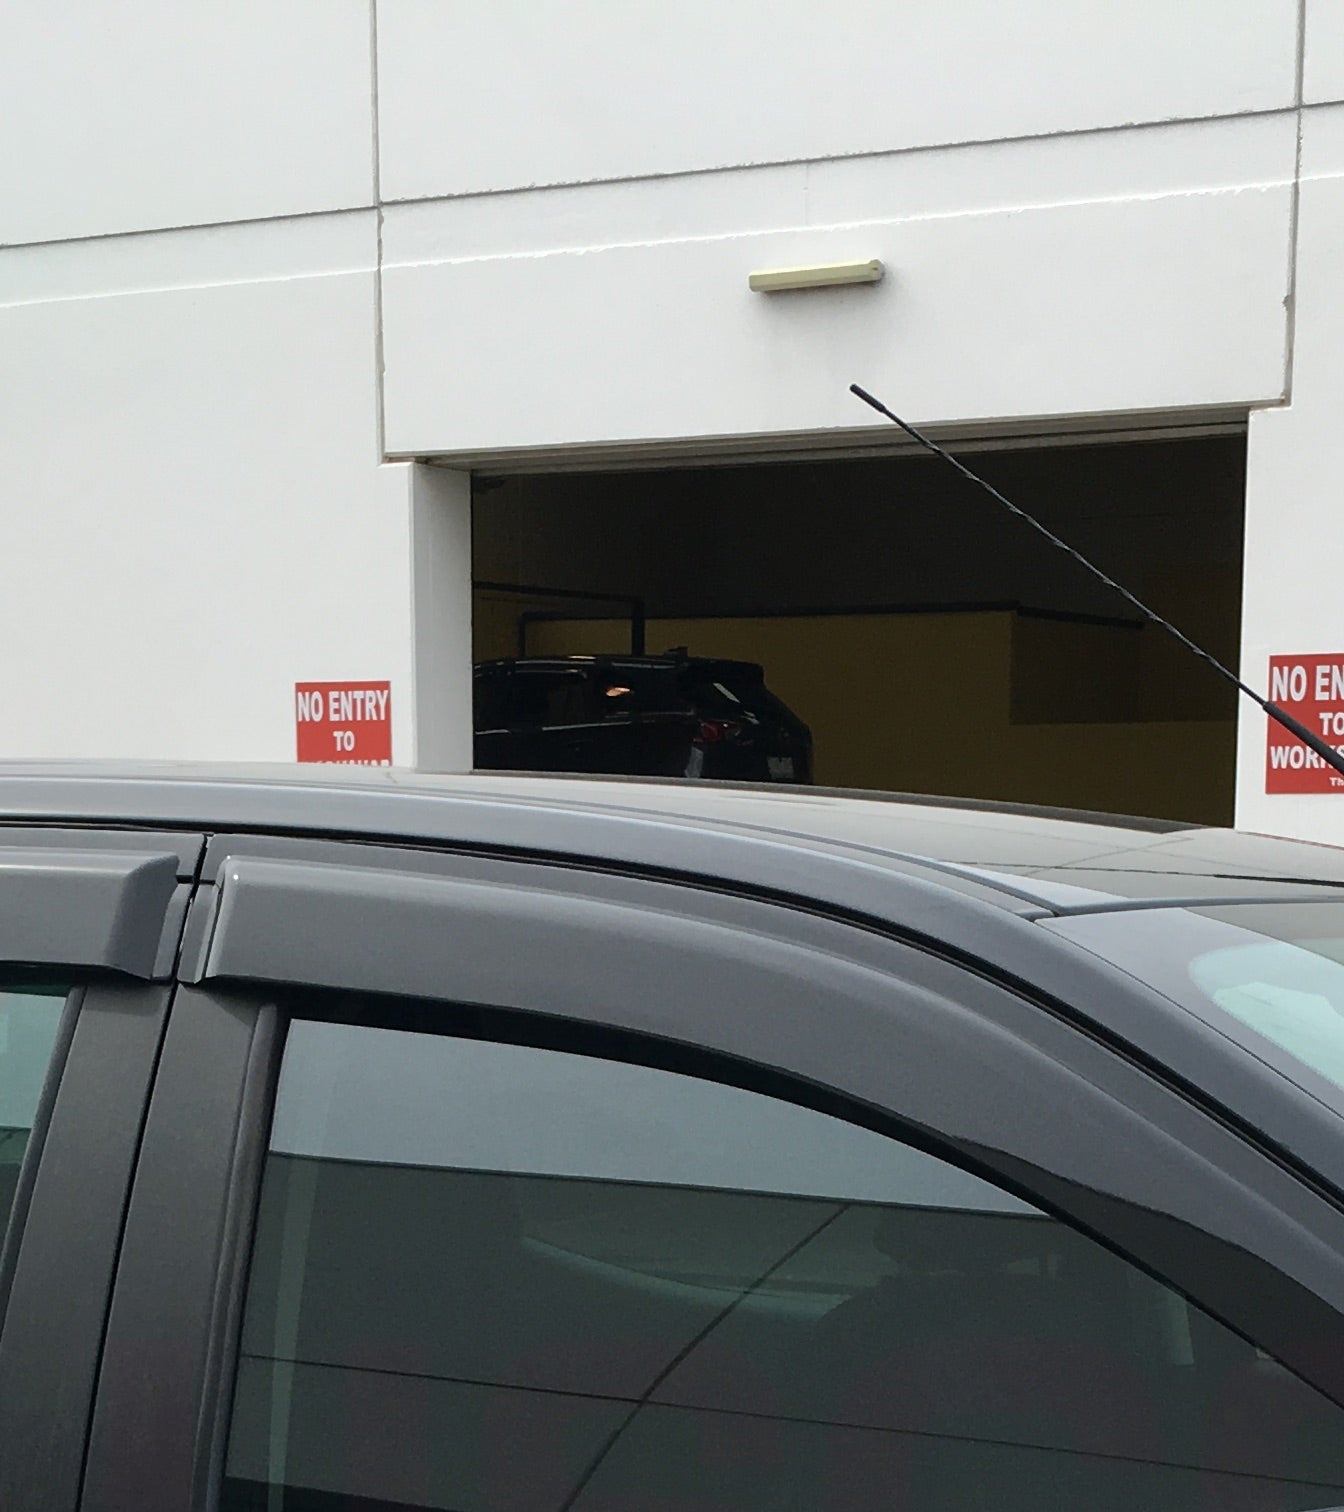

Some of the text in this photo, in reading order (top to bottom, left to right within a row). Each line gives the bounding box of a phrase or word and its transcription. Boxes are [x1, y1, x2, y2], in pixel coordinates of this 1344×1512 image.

[1271, 665, 1307, 702] NO
[297, 689, 389, 722] NO ENTRY
[333, 730, 355, 752] TO
